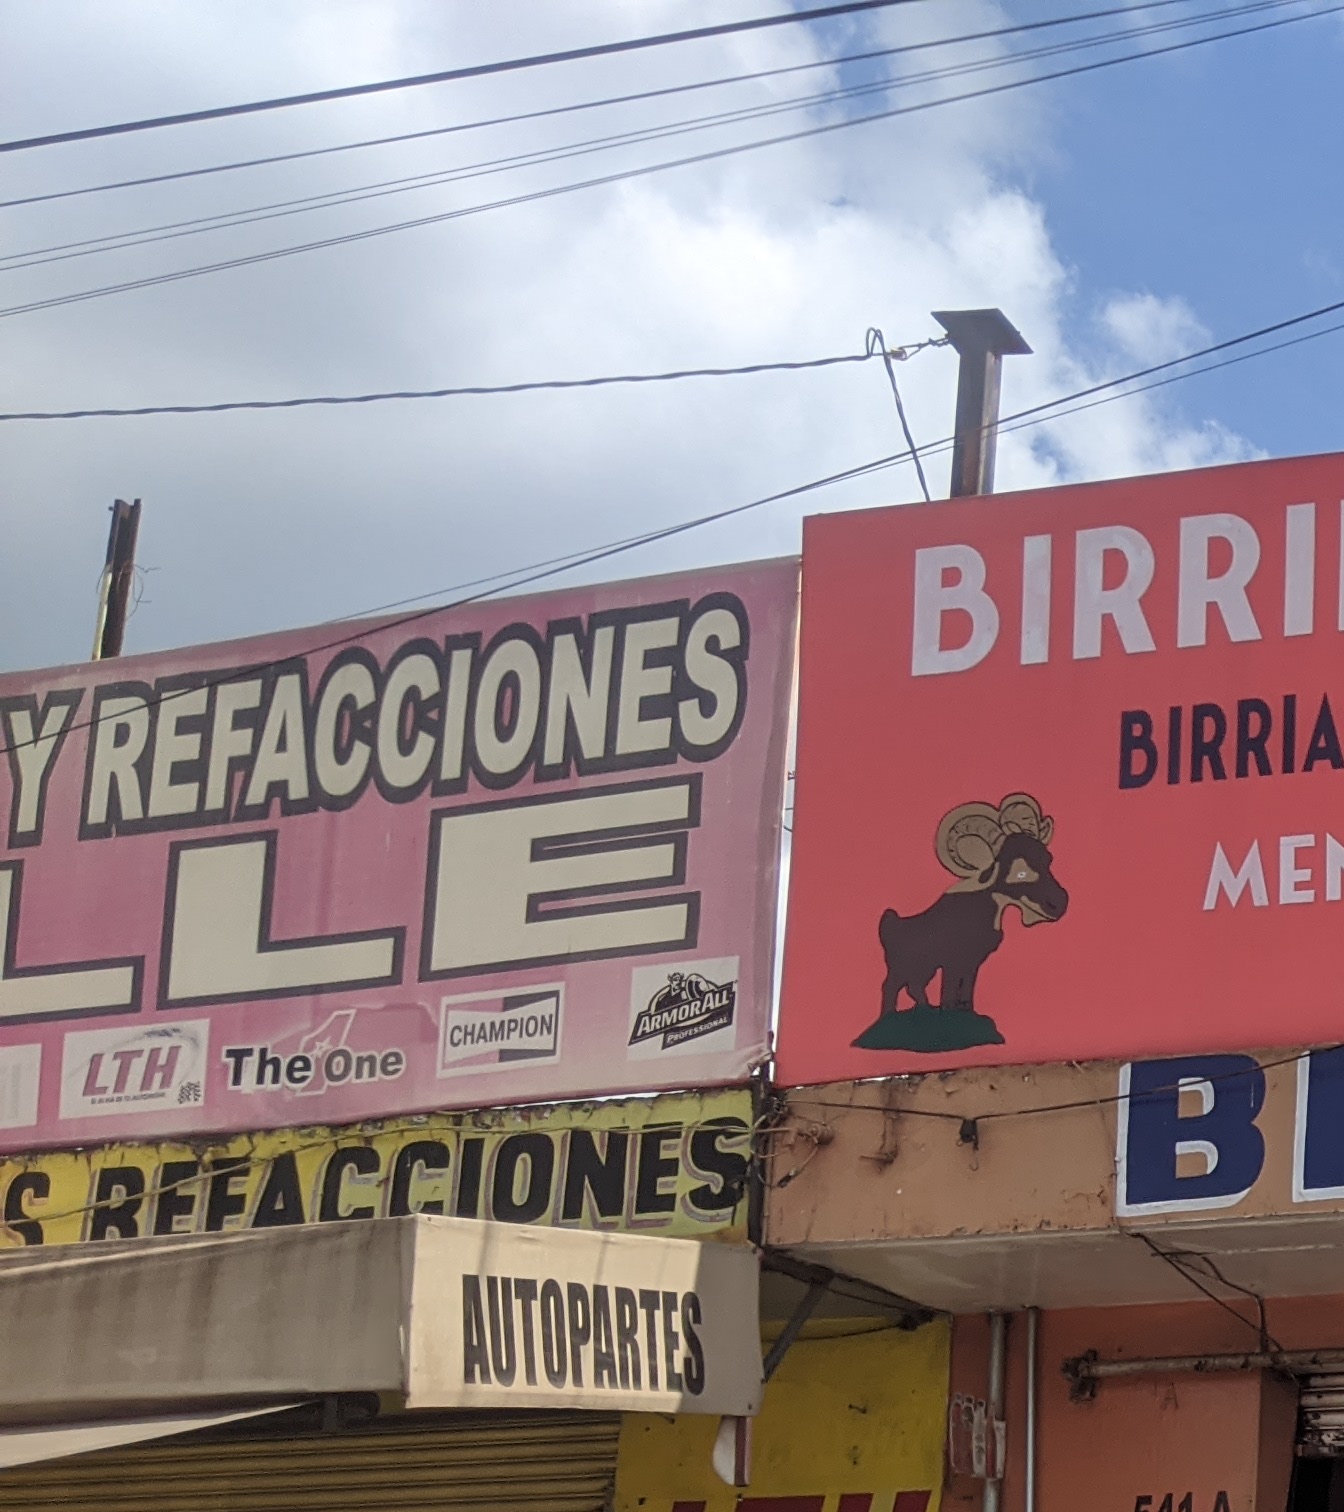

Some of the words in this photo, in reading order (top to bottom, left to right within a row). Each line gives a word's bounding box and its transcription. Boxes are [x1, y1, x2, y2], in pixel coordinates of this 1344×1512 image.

[4, 690, 84, 848] Y
[79, 593, 750, 841] REFACCIONES
[82, 1045, 183, 1097] LTH
[224, 1047, 312, 1088] The
[322, 1043, 405, 1082] One
[450, 1014, 553, 1051] CHAMPION
[92, 1116, 752, 1241] REFACCIONES
[462, 1274, 706, 1396] AUTOPARTES
